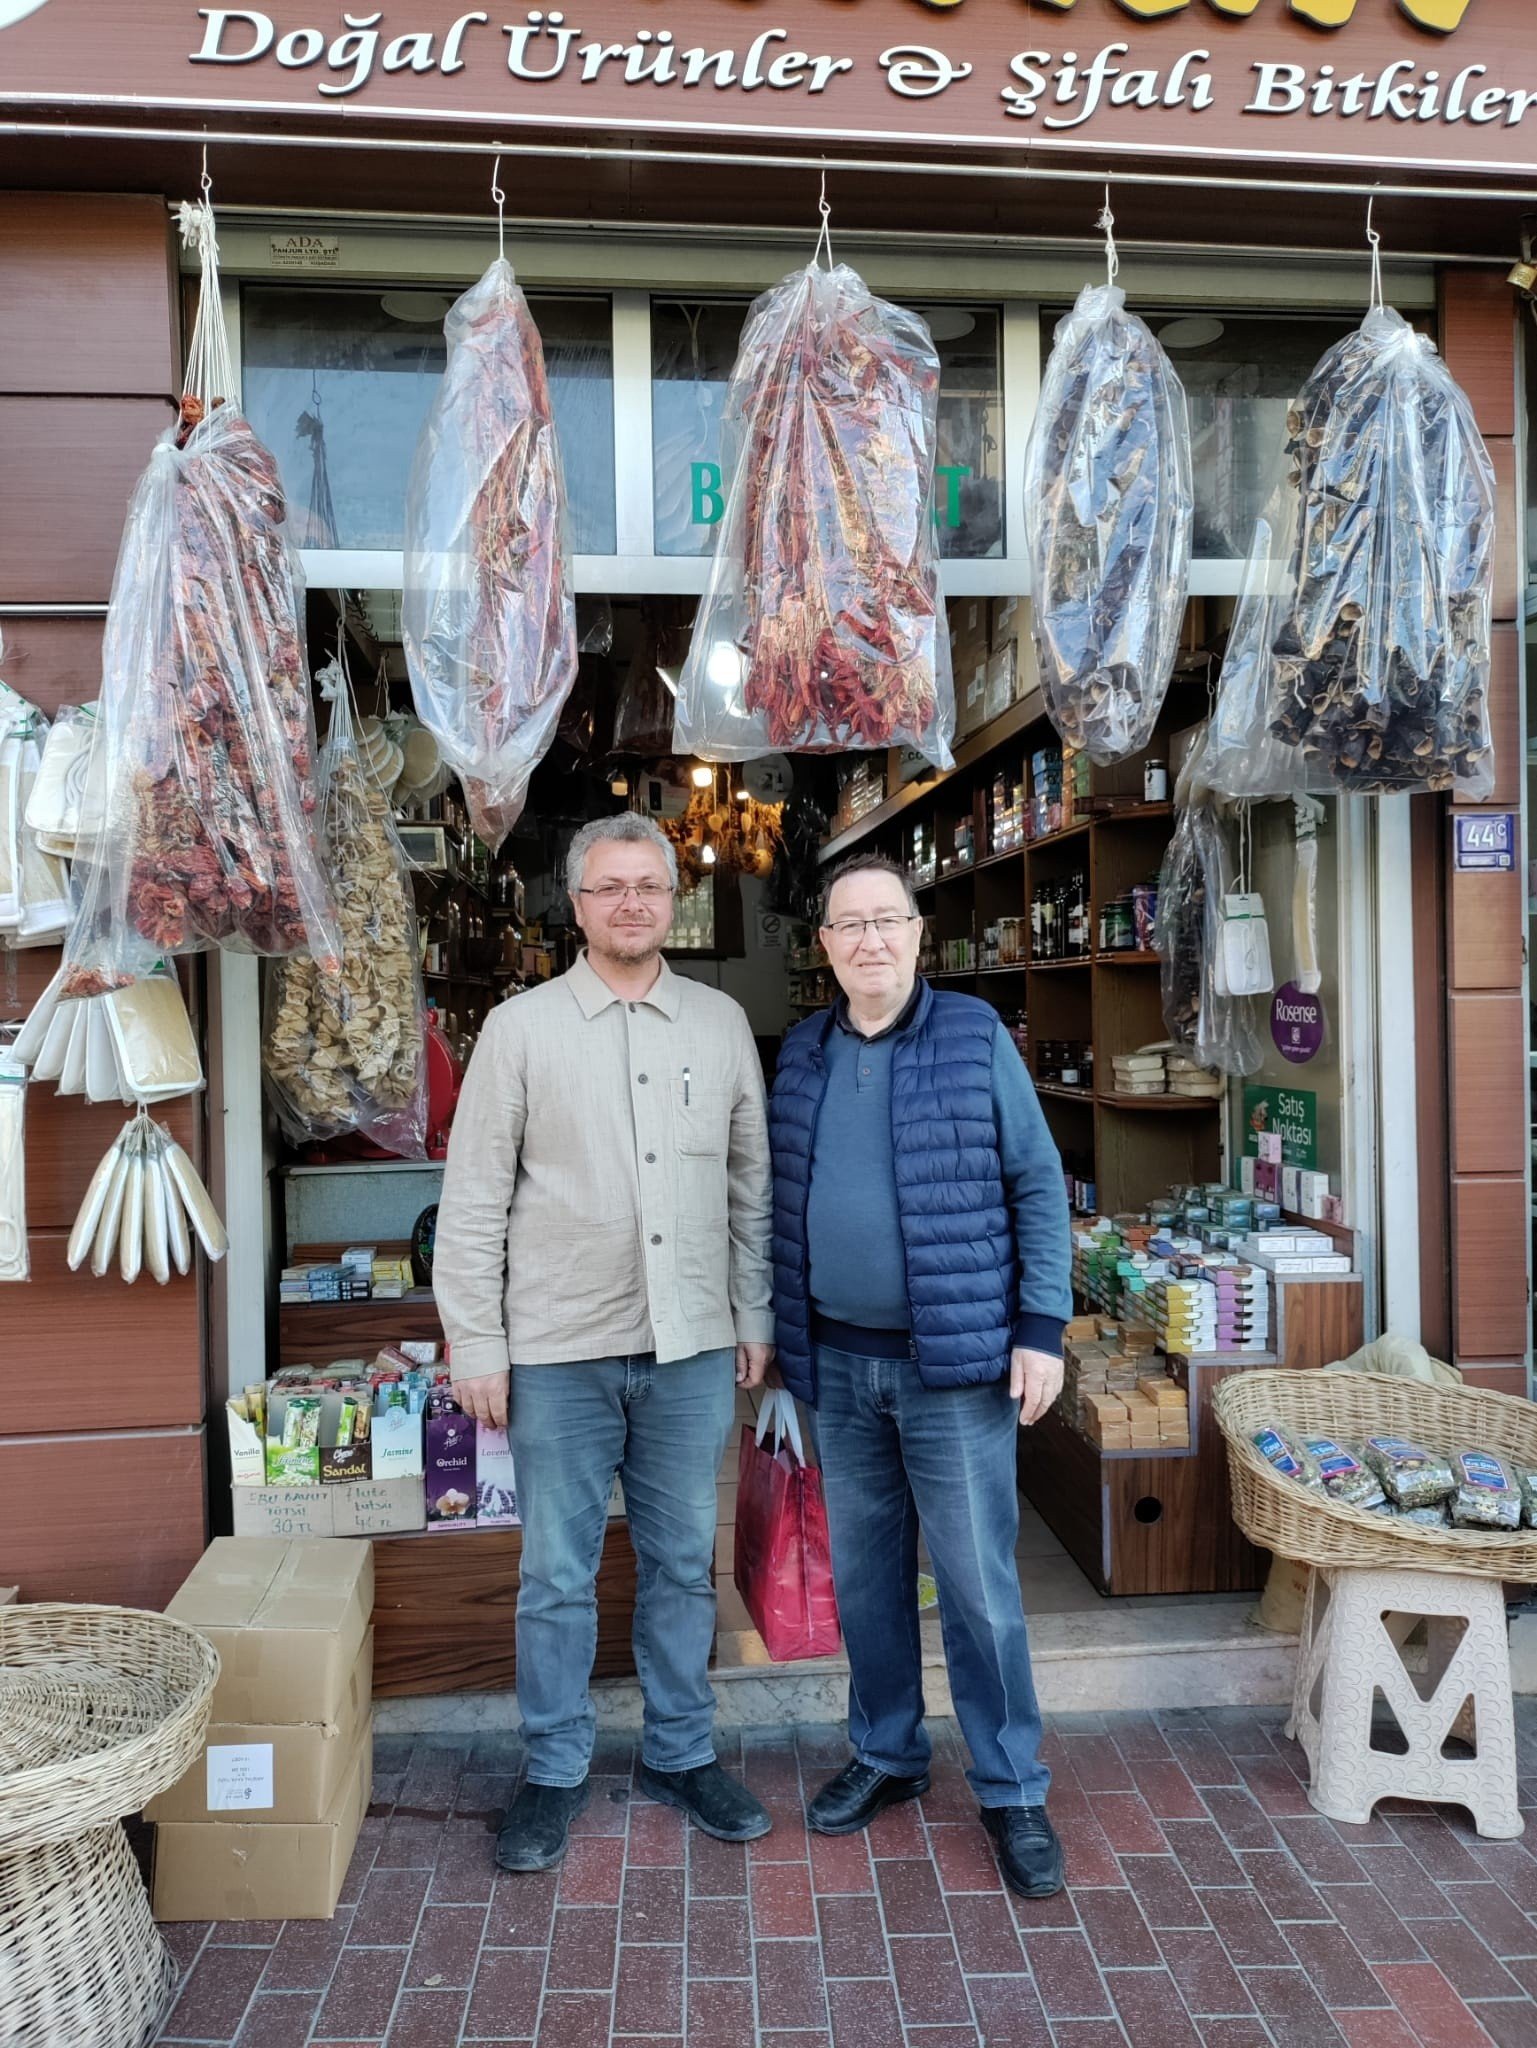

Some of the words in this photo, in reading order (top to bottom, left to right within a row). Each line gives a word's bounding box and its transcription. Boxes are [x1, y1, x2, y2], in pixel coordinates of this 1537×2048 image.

[189, 9, 487, 96] Doğal
[503, 11, 852, 93] Ürünler
[1001, 43, 1214, 130] Şifalı
[286, 236, 324, 247] ADA
[1276, 998, 1317, 1024] Rosense
[1278, 1093, 1305, 1123] Satış
[1272, 1117, 1312, 1146] Noktası
[234, 1448, 260, 1457] Vanilla
[382, 1448, 414, 1458] Jasmine
[436, 1457, 467, 1468] Orchid
[323, 1464, 367, 1477] Sandal
[271, 1518, 293, 1534] 30
[296, 1522, 313, 1533] TL
